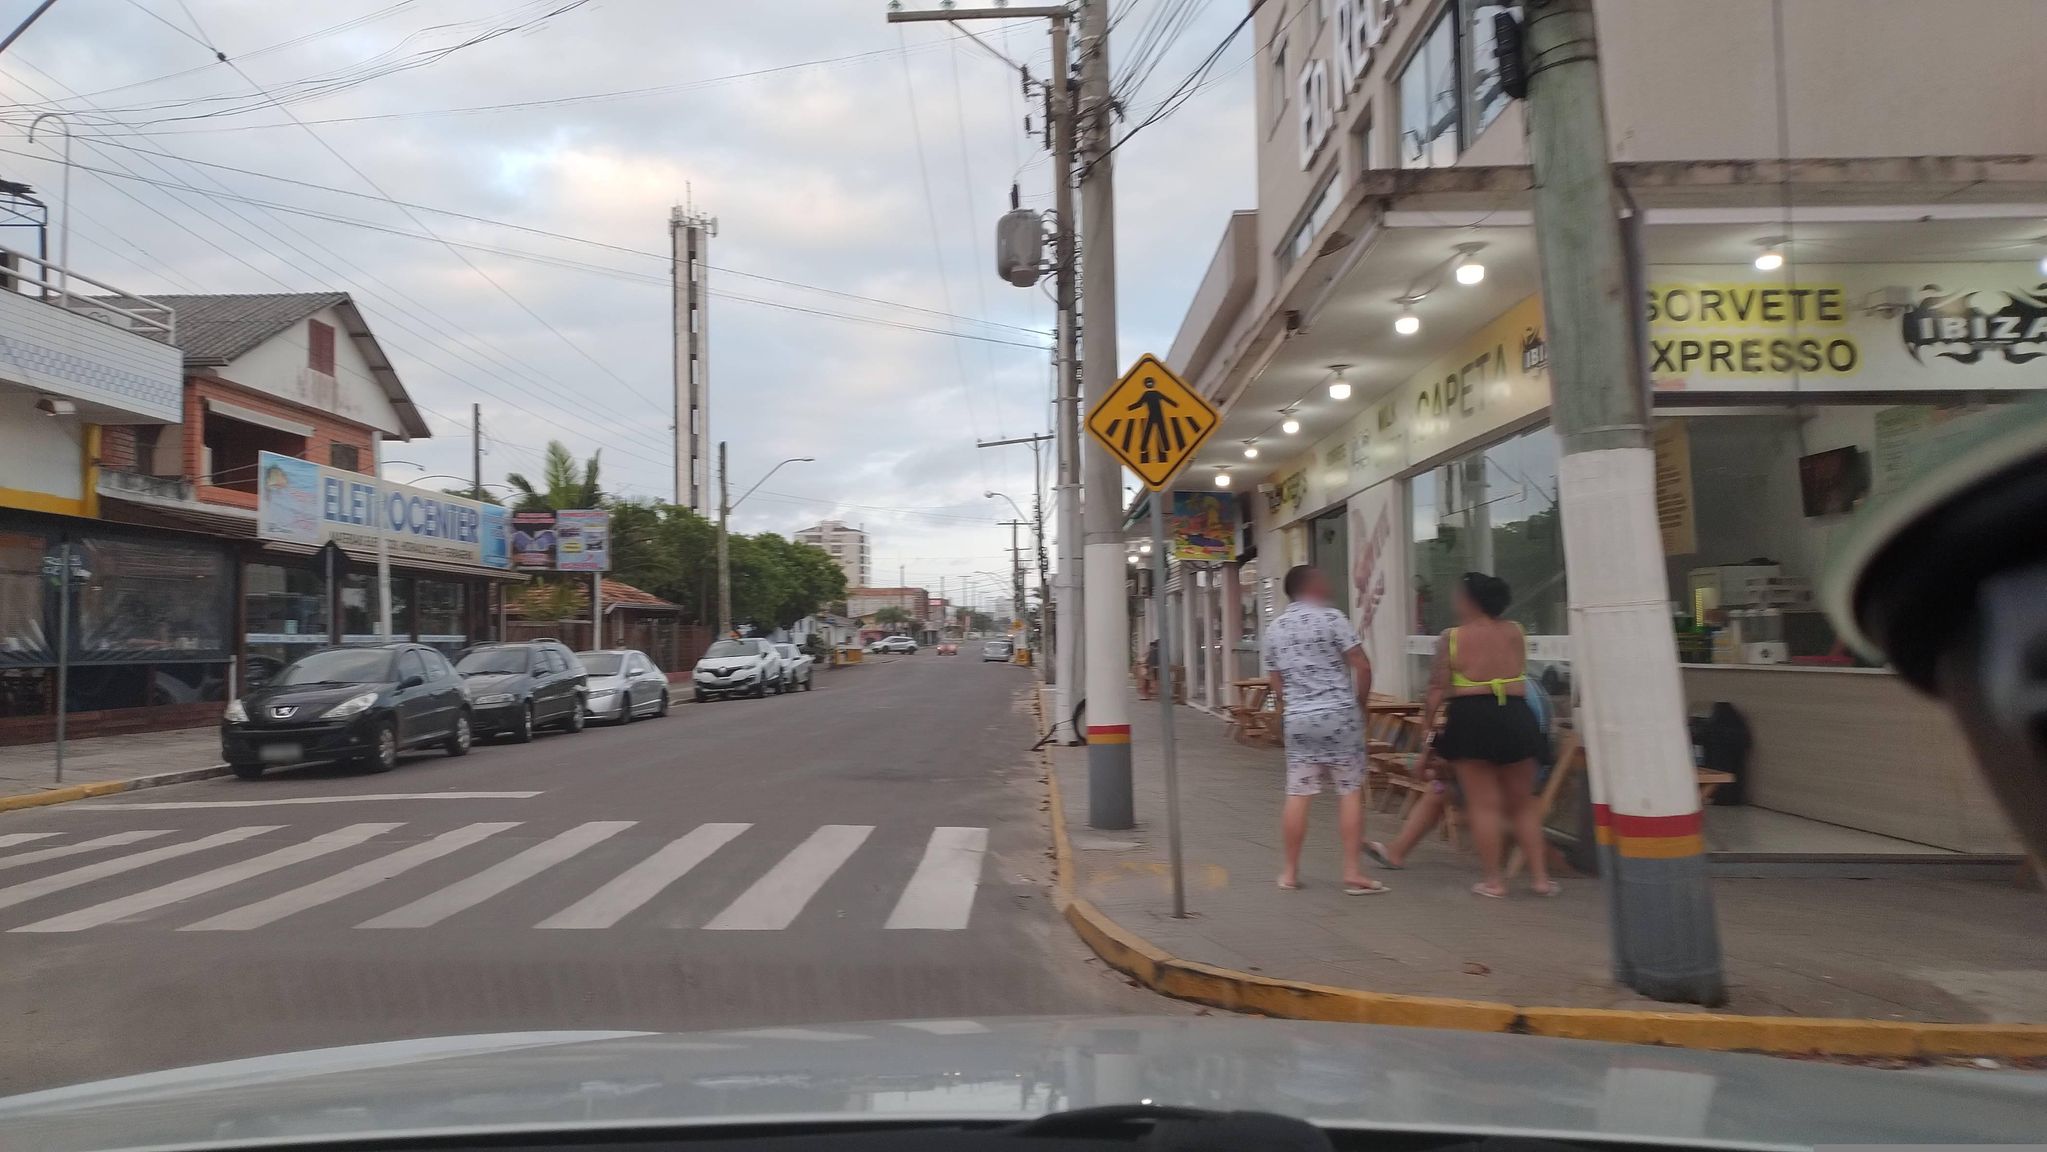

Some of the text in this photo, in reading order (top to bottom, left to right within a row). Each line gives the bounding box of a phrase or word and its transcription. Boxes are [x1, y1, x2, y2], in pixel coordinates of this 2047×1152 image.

[1648, 287, 1843, 322] SORVETE
[1918, 315, 2047, 340] IBIZA
[1650, 338, 1858, 373] XPRESSO
